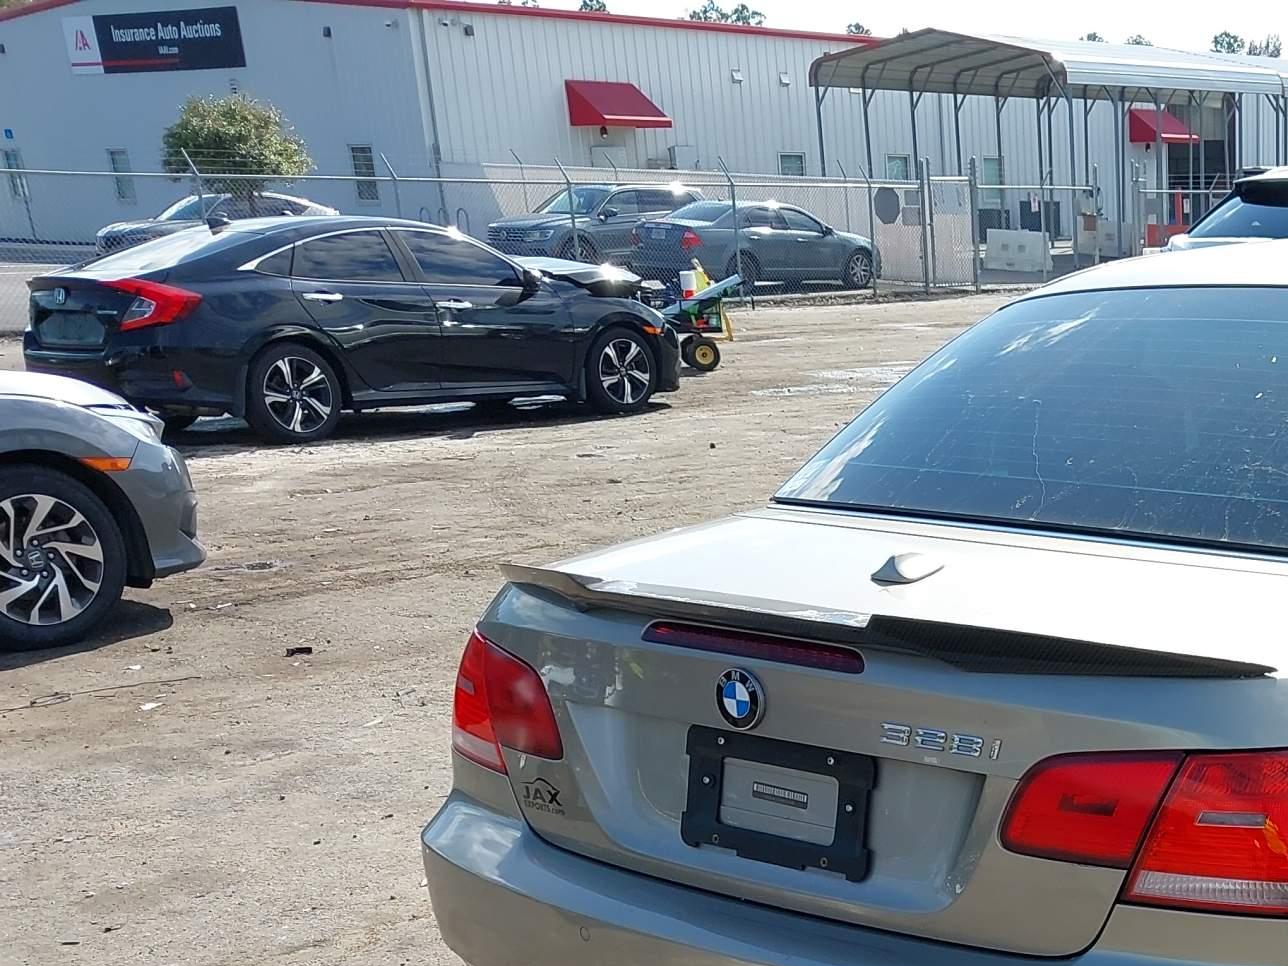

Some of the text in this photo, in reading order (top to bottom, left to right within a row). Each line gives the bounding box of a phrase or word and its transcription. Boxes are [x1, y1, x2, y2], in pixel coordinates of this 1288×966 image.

[111, 20, 222, 42] Insurance Auto Auctions
[720, 670, 755, 692] BMW
[880, 721, 1002, 760] 328i
[523, 785, 562, 806] JAX
